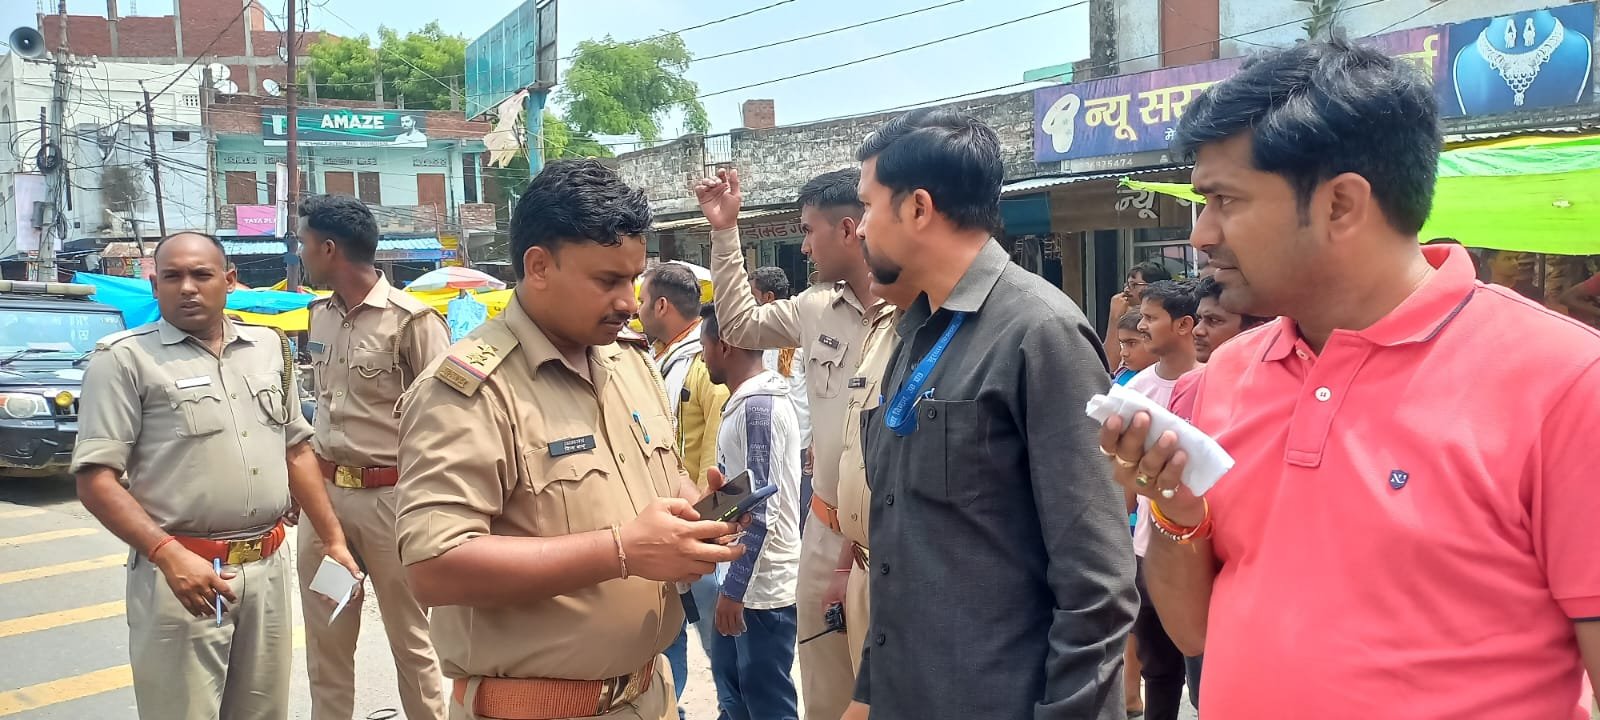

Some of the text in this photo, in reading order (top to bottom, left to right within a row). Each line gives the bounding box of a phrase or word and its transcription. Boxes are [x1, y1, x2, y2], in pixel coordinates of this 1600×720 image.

[320, 114, 385, 129] AMAZE
[1085, 94, 1138, 141] न्यू
[1115, 188, 1158, 219] न्यू
